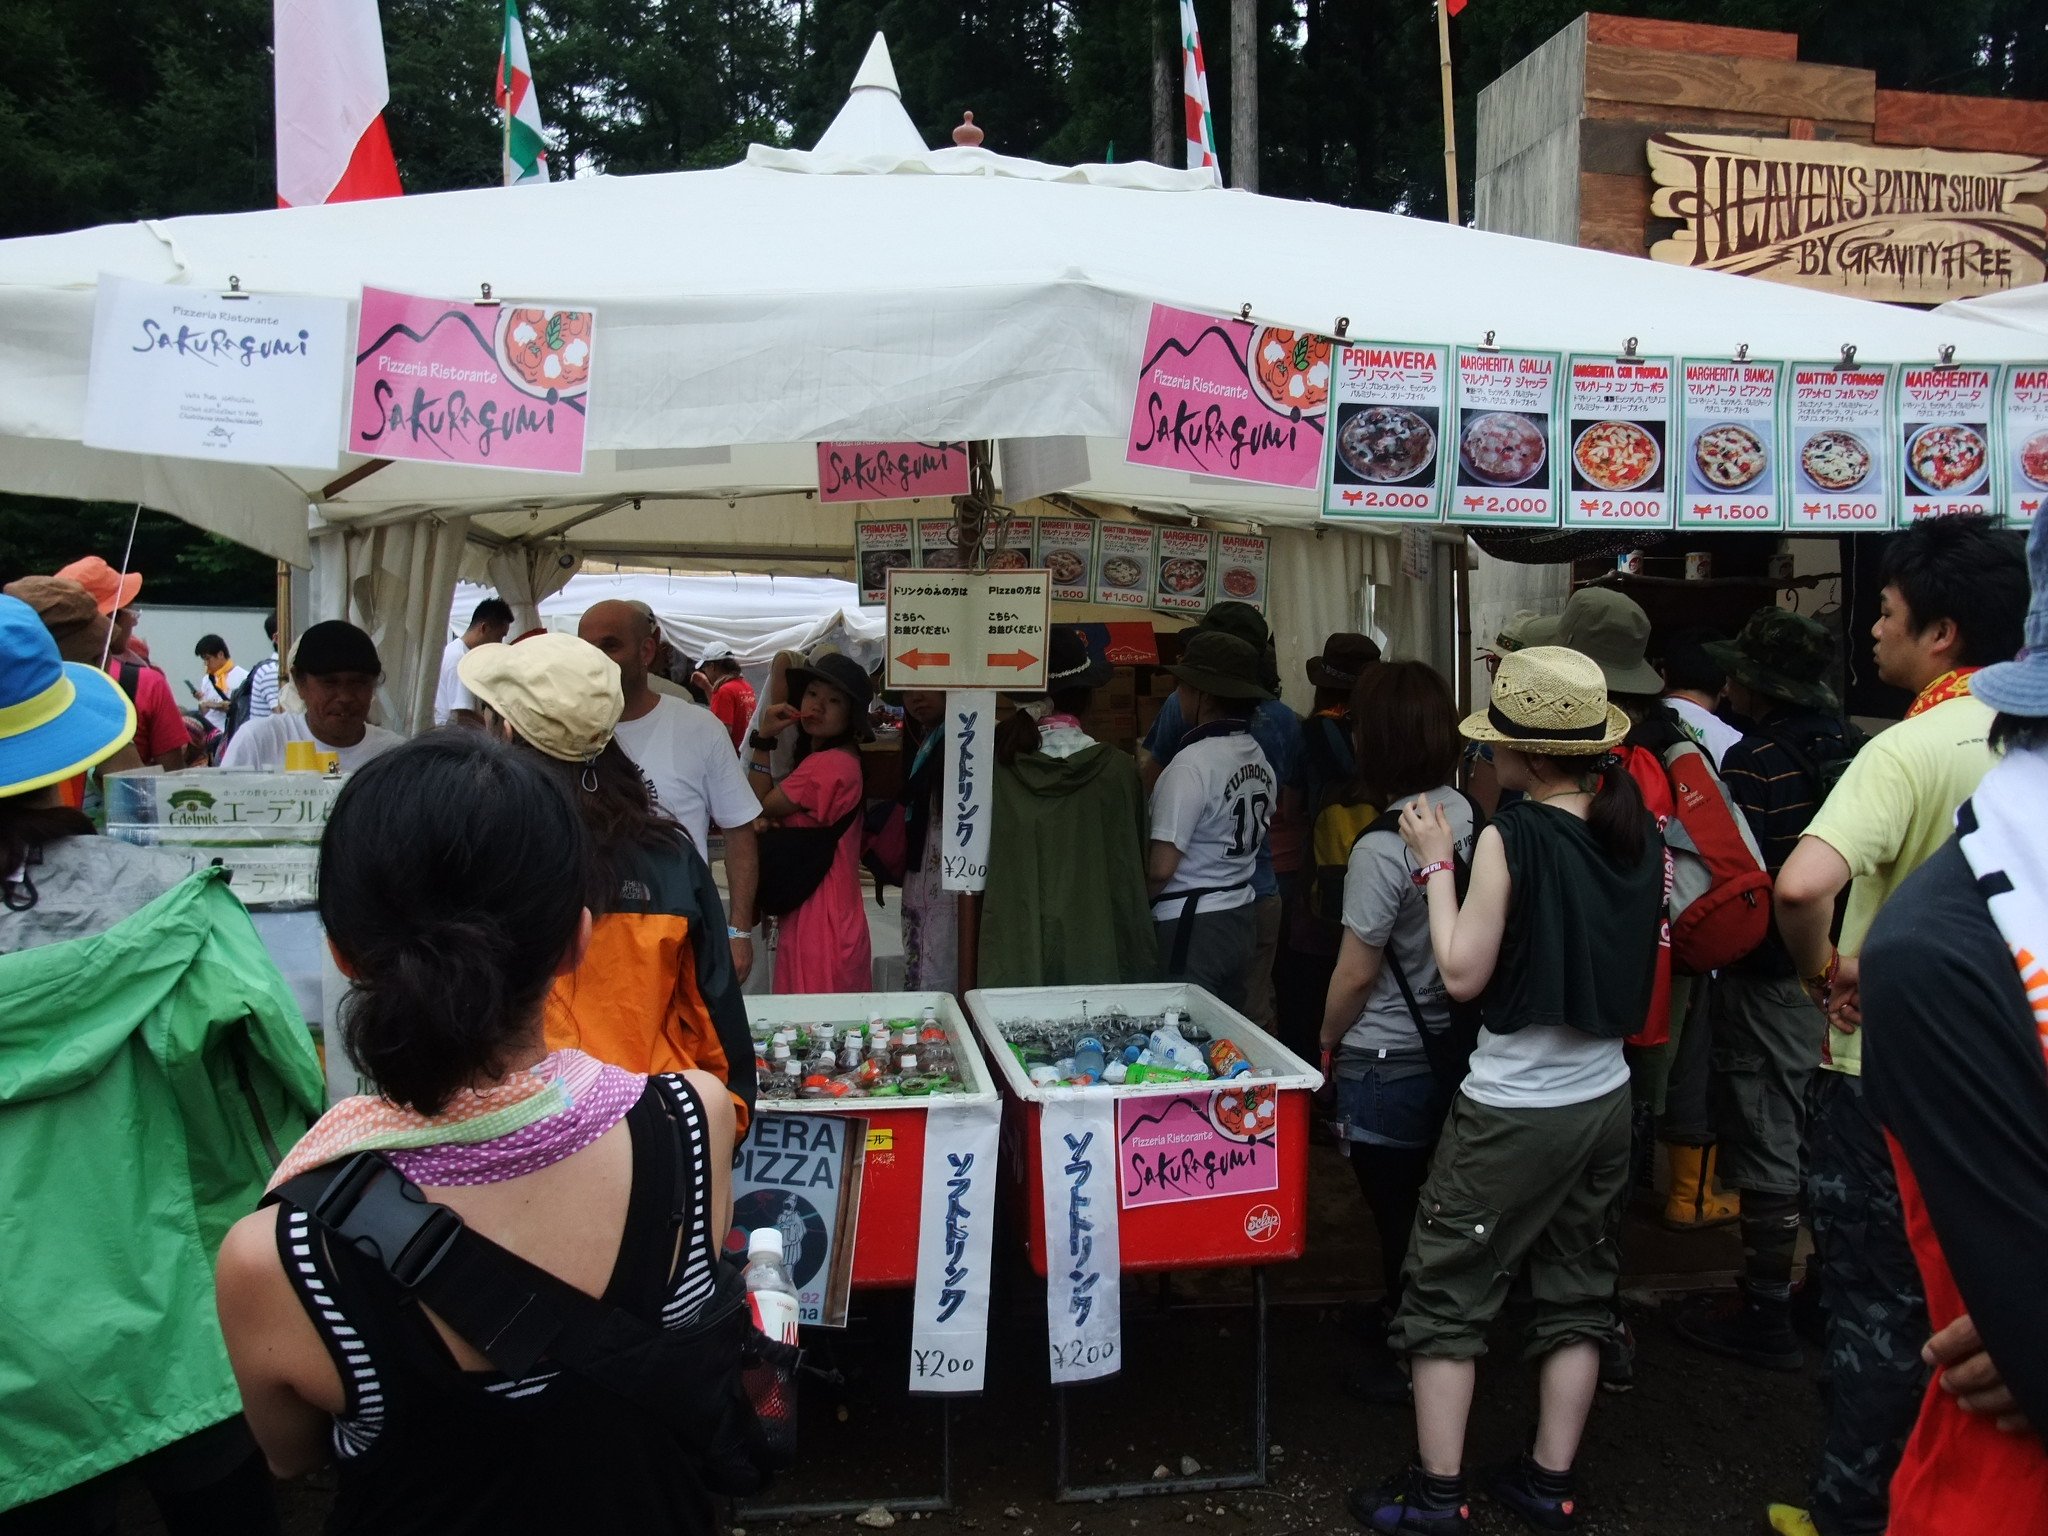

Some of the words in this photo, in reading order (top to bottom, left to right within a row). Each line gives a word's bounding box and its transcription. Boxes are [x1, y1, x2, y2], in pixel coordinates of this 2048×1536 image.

[1669, 154, 1875, 266] HEAVENS
[1798, 234, 1843, 276] BY
[172, 305, 217, 320] Pizzeria
[219, 312, 279, 326] Ristorante
[1342, 348, 1437, 371] PRIMAVERA
[1461, 355, 1515, 373] MARGHERITA
[1519, 358, 1552, 375] GIALLA
[378, 356, 428, 376] Pizzeria
[430, 363, 498, 384] Ristorante
[1348, 368, 1434, 384] プリマベーラ
[1686, 366, 1739, 381] MARGHERITA
[1744, 368, 1774, 383] BIANCA
[1153, 369, 1191, 390] Pizzeria
[1192, 377, 1249, 400] Ristorante
[1462, 373, 1512, 387] マルゲリータ
[1515, 376, 1548, 389] ジャッラ
[1574, 381, 1613, 393] マルゲリータ
[1615, 383, 1628, 393] コン
[1796, 372, 1838, 385] QUATTRO
[1841, 373, 1885, 386] FORMAGGI
[1905, 371, 1989, 388] MARGHERITA
[1688, 384, 1737, 397] マルゲリータ
[1740, 385, 1772, 397] ビアンカ
[1910, 390, 1982, 402] マルゲリータ
[1342, 490, 1429, 509] ¥2,000
[1464, 494, 1548, 514] ¥2,000
[1580, 498, 1661, 518] ¥2,000
[1693, 503, 1769, 520] ¥1,500
[1803, 502, 1877, 521] ¥1,500
[860, 523, 908, 534] PRIMAVERA
[1163, 530, 1208, 543] MARGHERITA
[1223, 536, 1265, 549] MARINARA
[894, 586, 968, 596] ドリンクのみの方は
[989, 586, 1041, 595] Pizzaの方は
[1052, 590, 1084, 599] 1,500
[1102, 591, 1143, 603] ¥1,500
[1162, 597, 1201, 608] ¥1,500
[894, 613, 926, 622] こちらへ
[988, 612, 1019, 621] こちらへ
[894, 626, 950, 635] お並びください
[988, 625, 1042, 635] お並びください
[955, 711, 979, 847] ソフトドリンク
[1224, 763, 1273, 804] FUJIROCK
[943, 855, 988, 879] ¥200
[1132, 1133, 1166, 1148] Pizzeria
[1166, 1130, 1213, 1145] Ristorante
[732, 1149, 835, 1190] PIZZA
[1063, 1131, 1100, 1327] ソフトドリンク
[936, 1153, 974, 1323] ソフトドリンク
[1053, 1339, 1115, 1369] ¥200
[914, 1349, 974, 1378] ¥200
